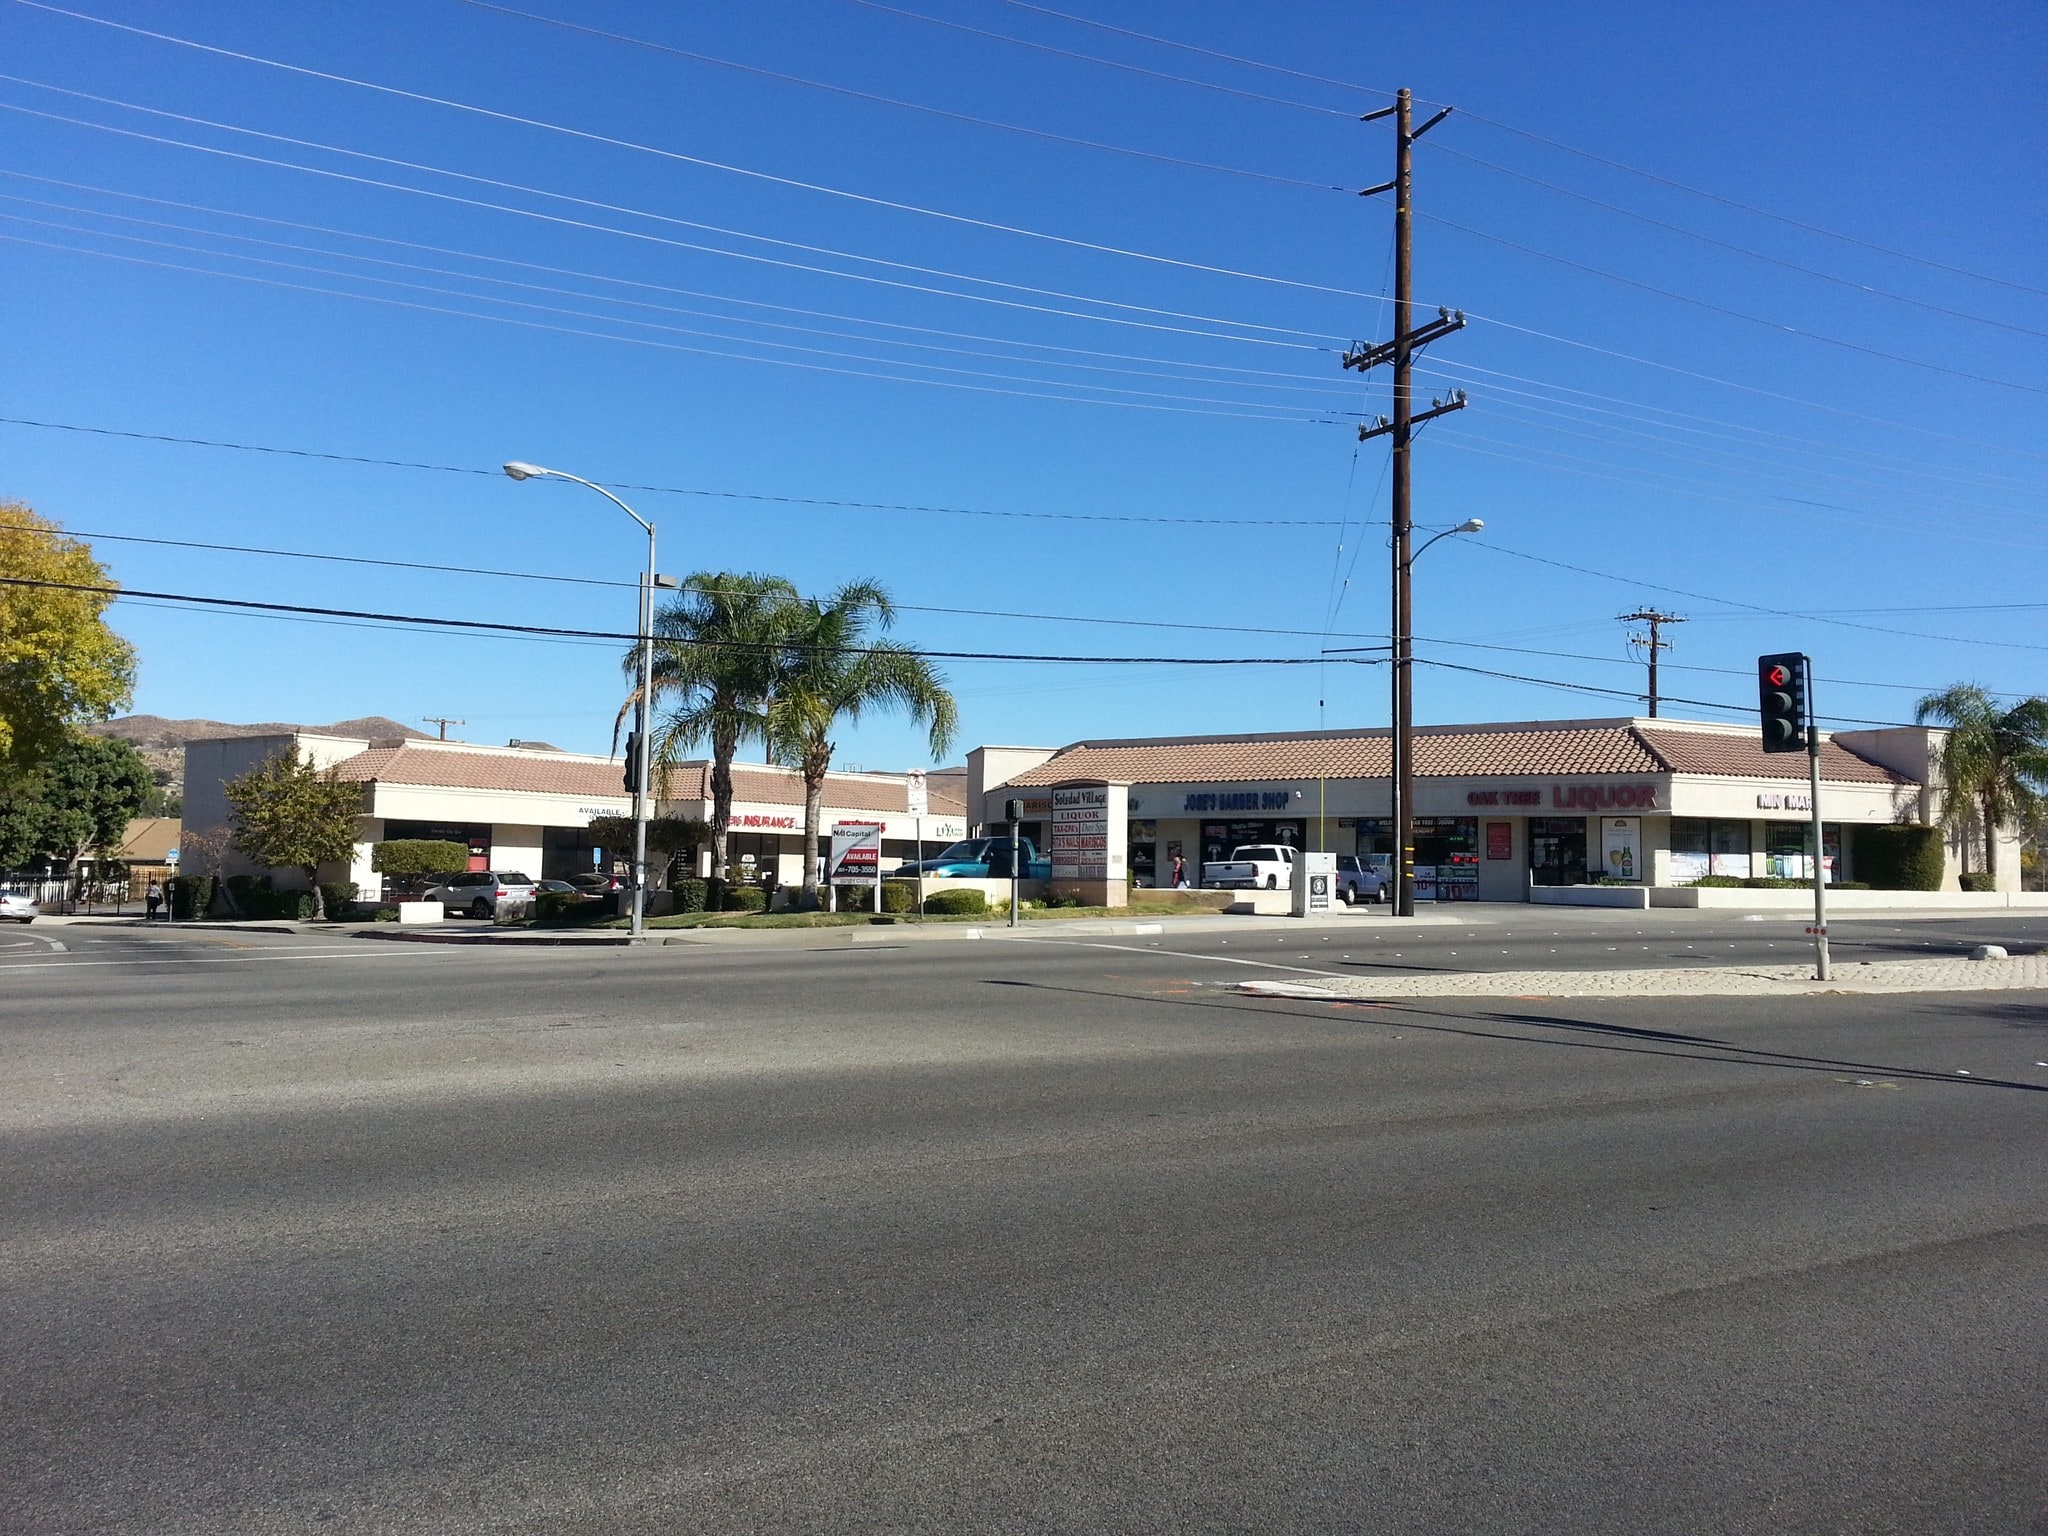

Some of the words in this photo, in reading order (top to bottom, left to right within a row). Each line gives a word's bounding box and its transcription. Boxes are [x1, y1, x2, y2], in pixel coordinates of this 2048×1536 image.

[1023, 800, 1052, 810] ARISC
[1054, 792, 1080, 806] Soledad
[1081, 790, 1107, 806] Village
[1219, 792, 1260, 811] BARBER
[1262, 791, 1290, 810] SHOP
[1467, 791, 1499, 806] OAK
[1501, 790, 1541, 806] TREE
[1552, 785, 1658, 811] LIQUOR
[1784, 795, 1813, 811] MAR
[578, 807, 620, 816] AVAILABLE
[1061, 811, 1099, 820] LIQUOR
[743, 815, 796, 829] INSURANCE
[846, 830, 871, 838] Capital
